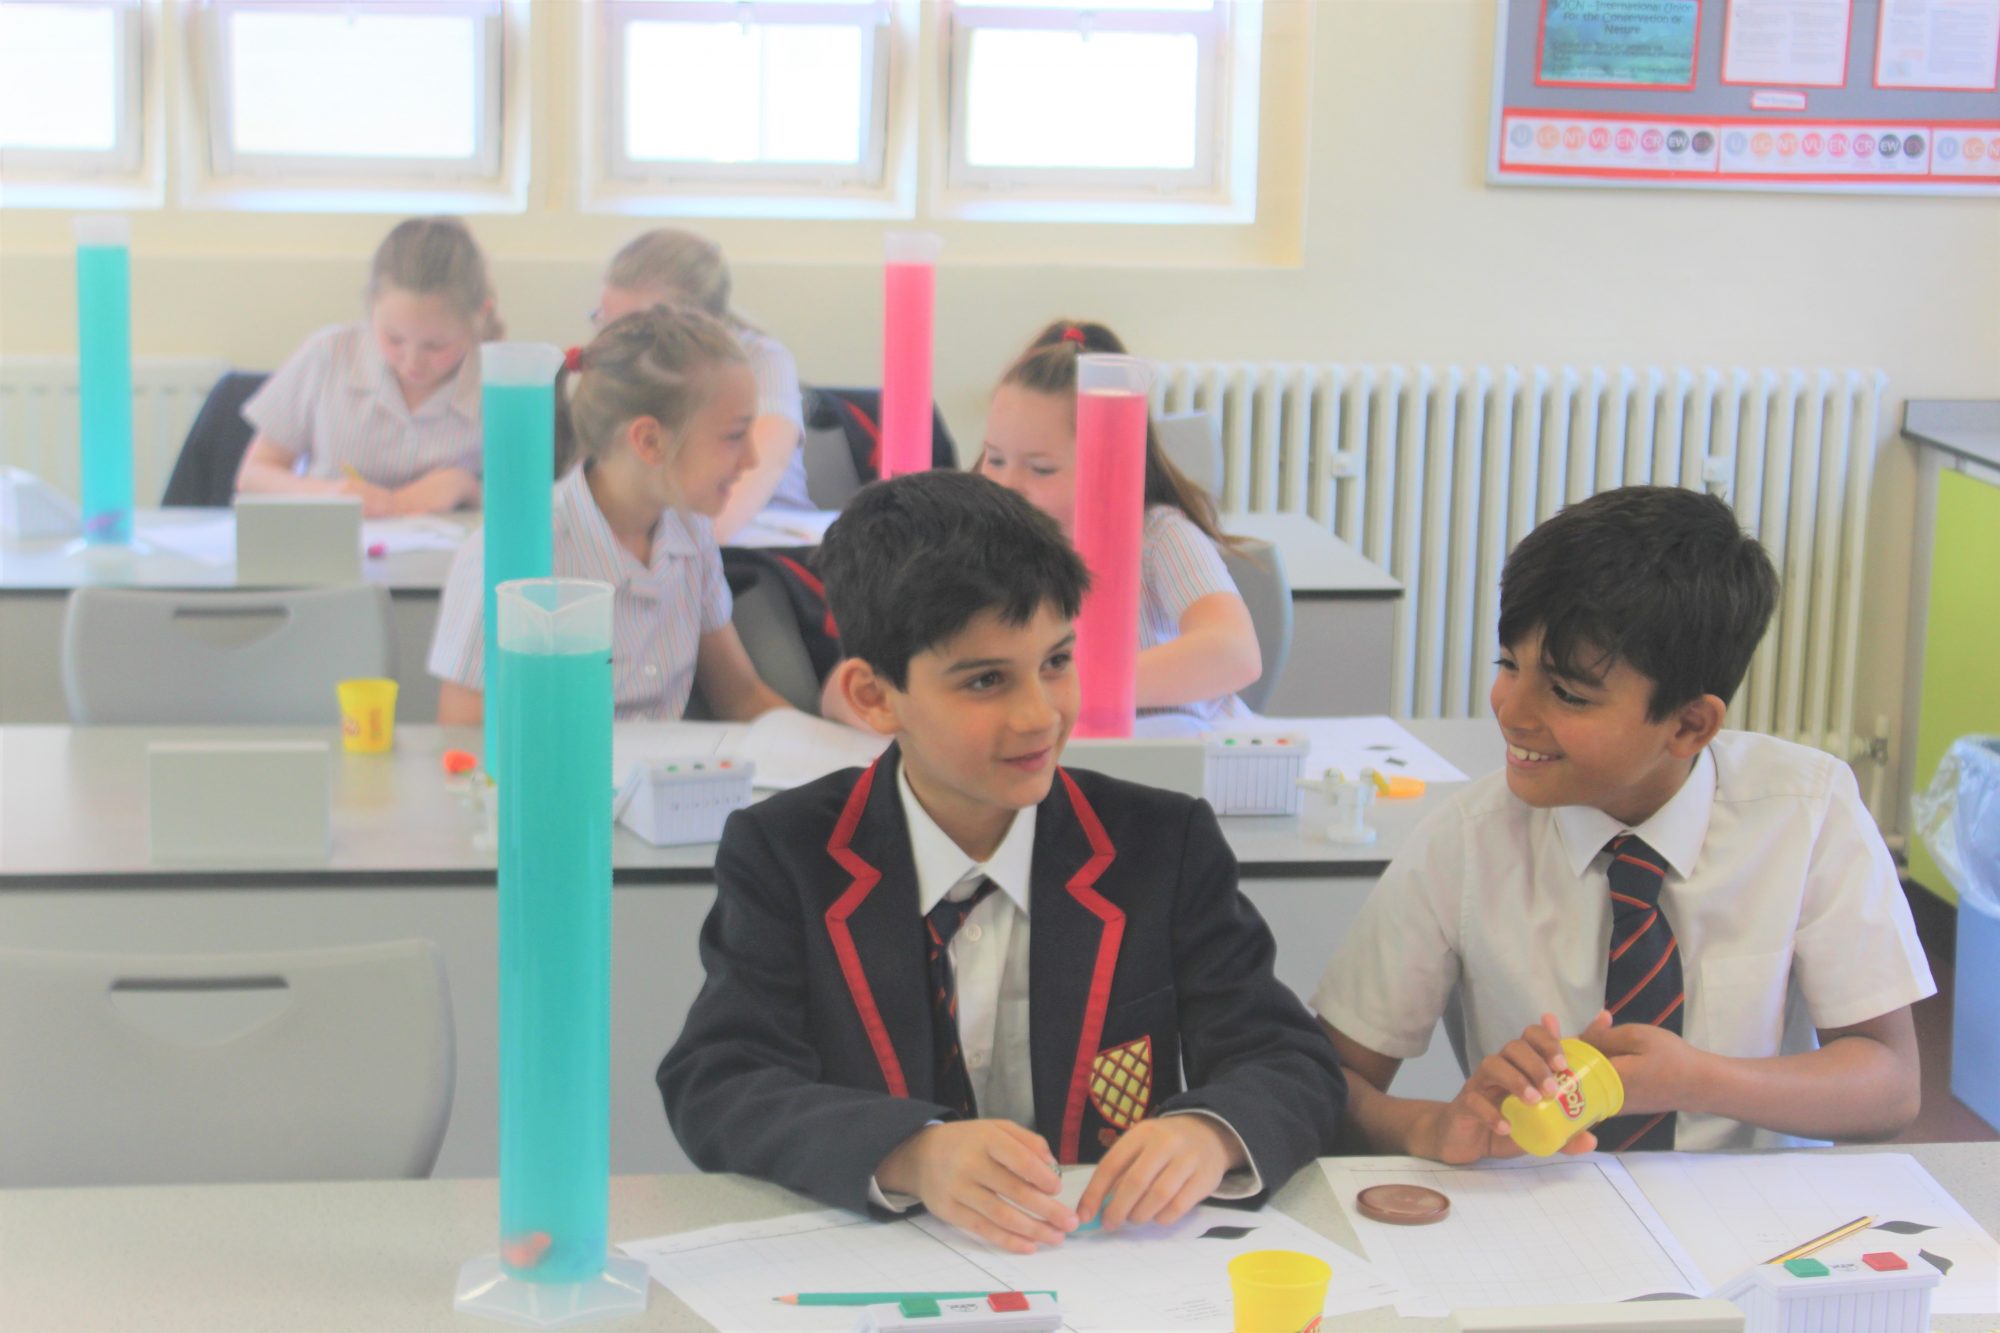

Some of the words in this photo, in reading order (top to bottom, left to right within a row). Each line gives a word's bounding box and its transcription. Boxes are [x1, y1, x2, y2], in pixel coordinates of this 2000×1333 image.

[1583, 11, 1600, 22] the
[1602, 12, 1669, 24] Conservation
[1604, 24, 1641, 35] Nature
[1563, 131, 1585, 146] NT
[1590, 132, 1611, 146] VU
[1616, 133, 1637, 148] EN
[1642, 135, 1662, 148] CR
[1668, 136, 1688, 148] EW
[1803, 138, 1824, 151] VU
[1829, 139, 1849, 153] EN
[1854, 140, 1874, 153] CR
[1880, 141, 1901, 152] EW
